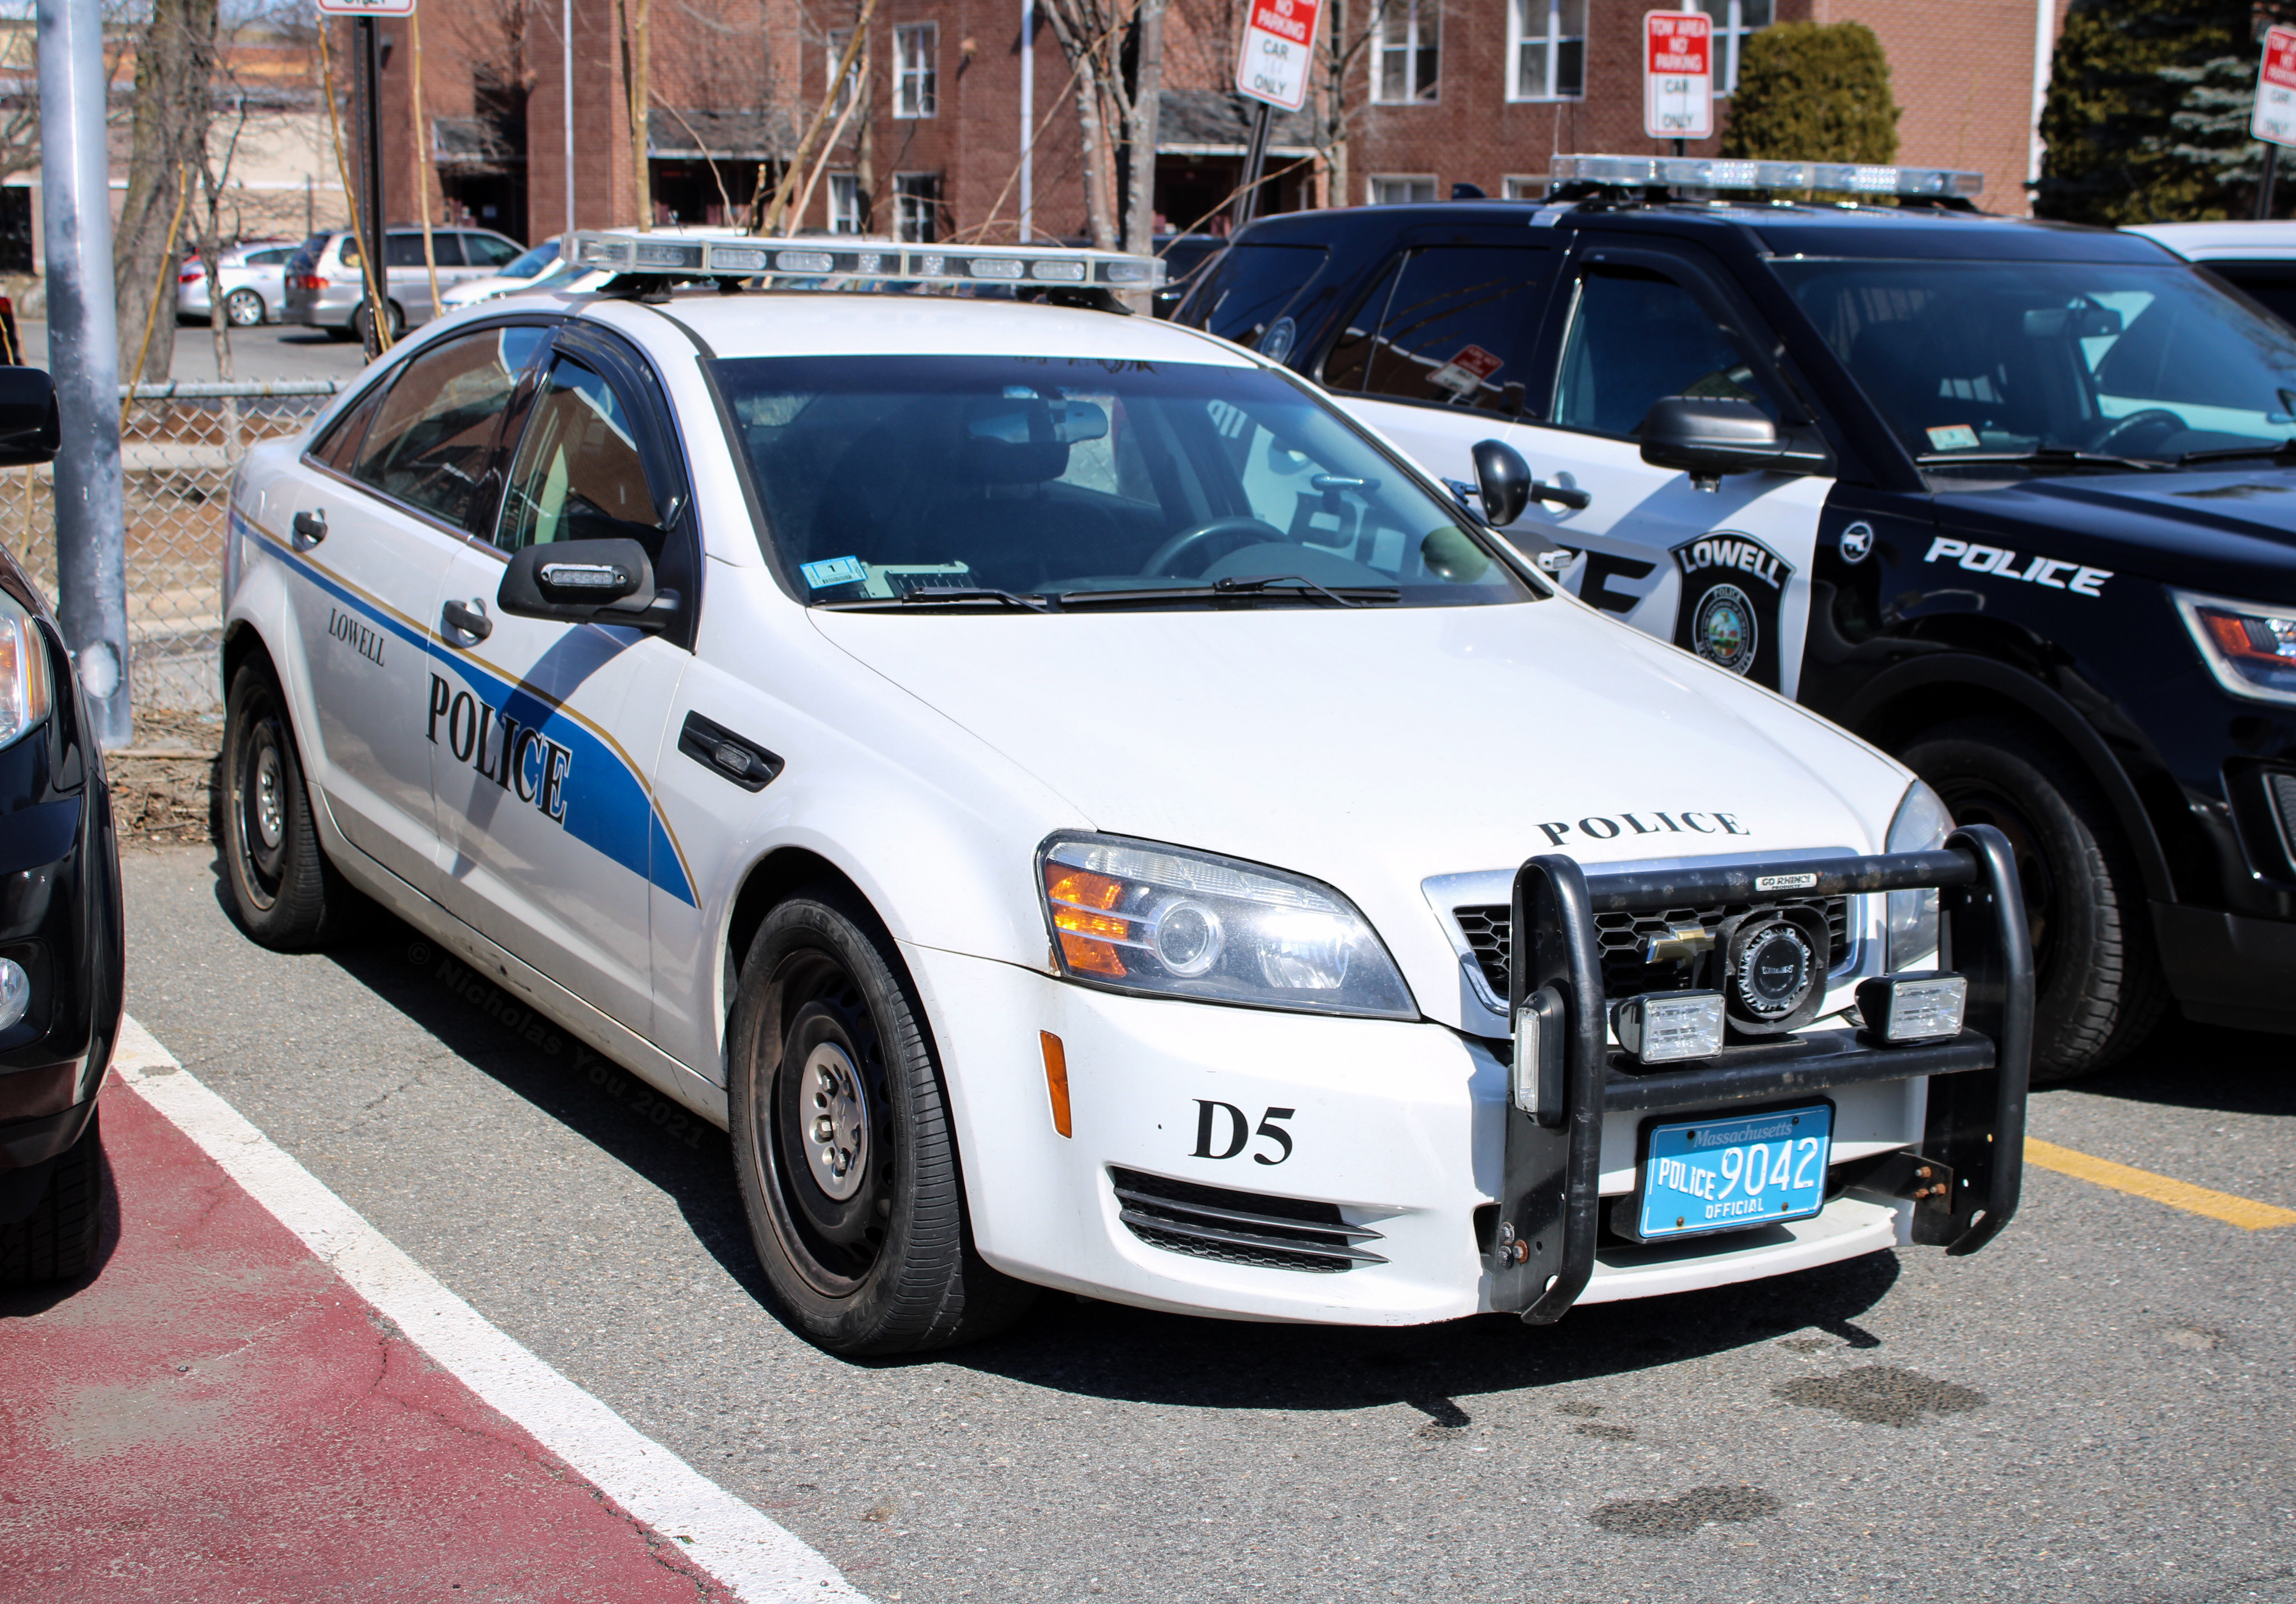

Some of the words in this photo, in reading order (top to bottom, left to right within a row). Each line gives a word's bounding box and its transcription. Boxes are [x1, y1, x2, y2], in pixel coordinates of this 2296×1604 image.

[1275, 0, 1294, 17] NO
[1256, 7, 1307, 41] PARKING
[1263, 39, 1288, 59] CAR
[1669, 36, 1689, 54] NO
[1655, 53, 1702, 72] PARKING
[1254, 73, 1287, 94] ONLY
[1665, 79, 1690, 94] CAR
[1663, 114, 1694, 128] ONLY
[1679, 540, 1780, 589] LOWELL
[1924, 537, 2114, 597] POLICE
[328, 608, 385, 667] LOWELL
[426, 672, 572, 828] POLICE
[1532, 812, 1750, 847] POLICE
[1188, 1099, 1296, 1165] D5
[1694, 1122, 1793, 1148] Massachusetts
[1658, 1157, 1717, 1200] POLICE
[1718, 1136, 1819, 1200] 9042
[1705, 1198, 1764, 1219] OFFICIAL
